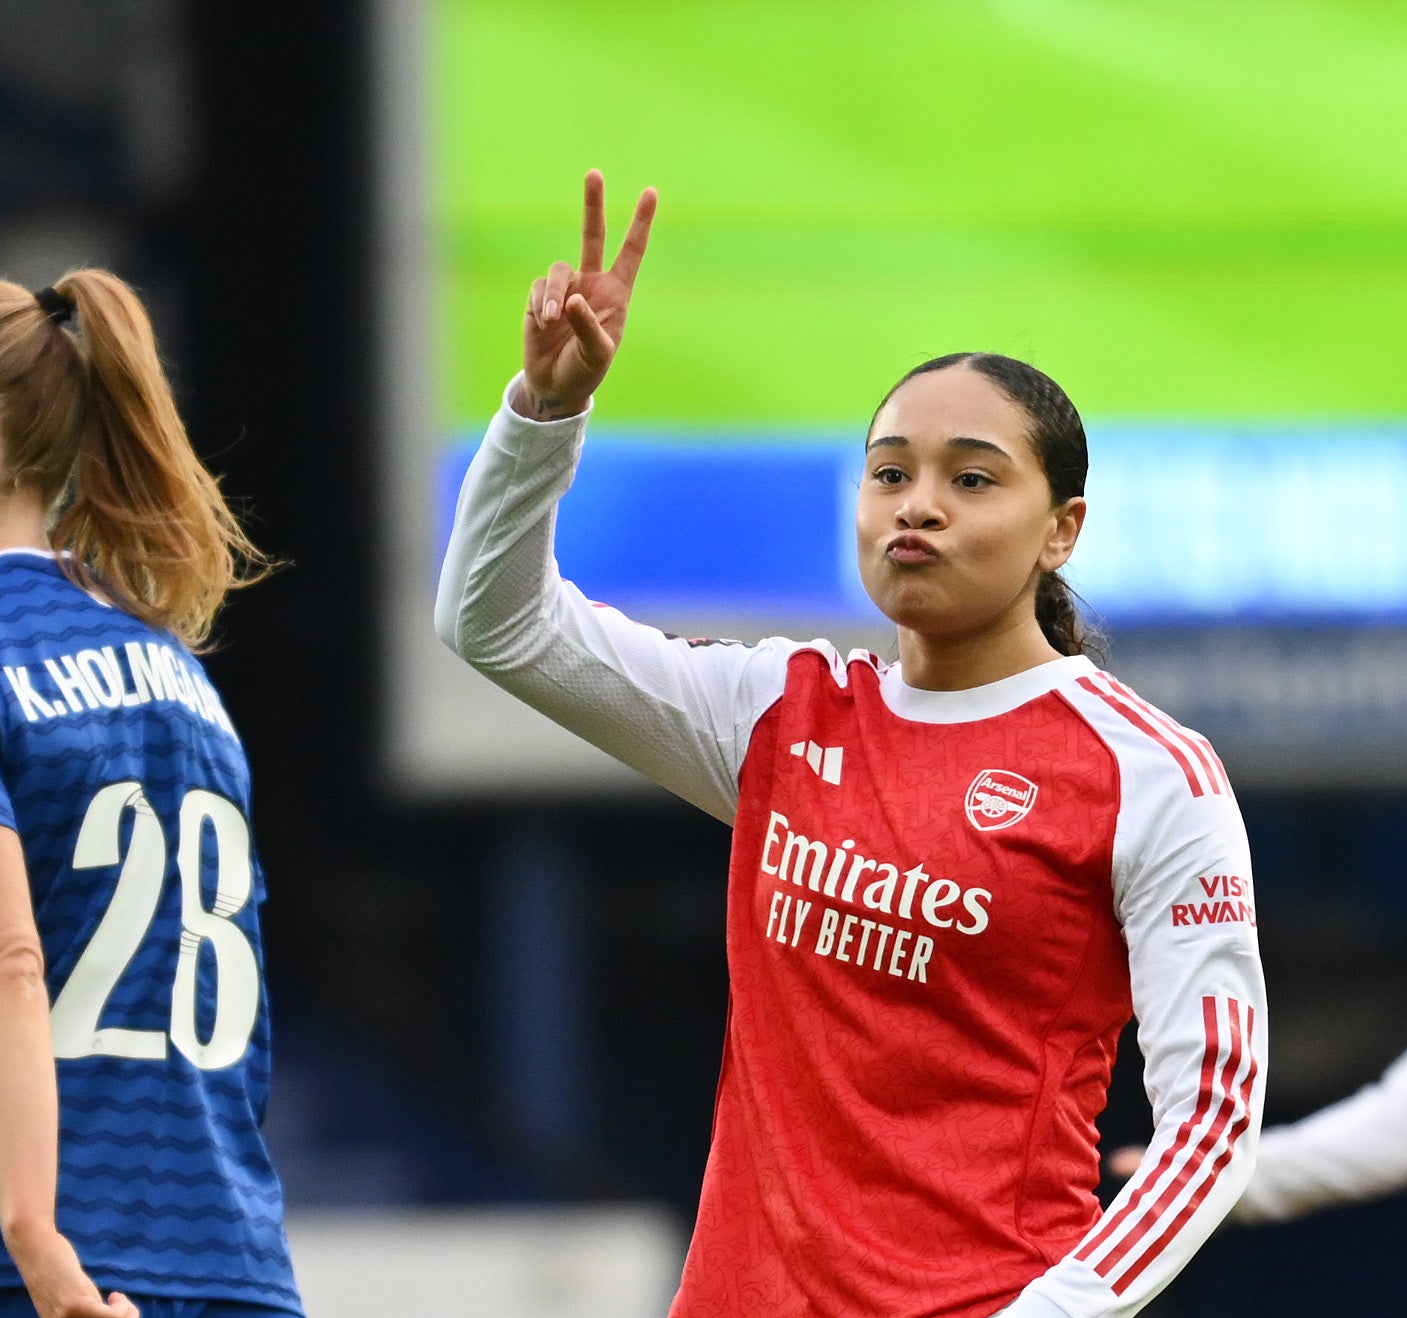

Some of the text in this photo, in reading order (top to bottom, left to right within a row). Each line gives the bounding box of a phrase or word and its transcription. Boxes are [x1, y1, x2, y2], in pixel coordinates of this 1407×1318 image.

[980, 777, 1028, 801] Arsenal
[49, 781, 258, 1070] 28
[761, 810, 992, 935] Emirates
[766, 890, 934, 984] FLY BETTER
